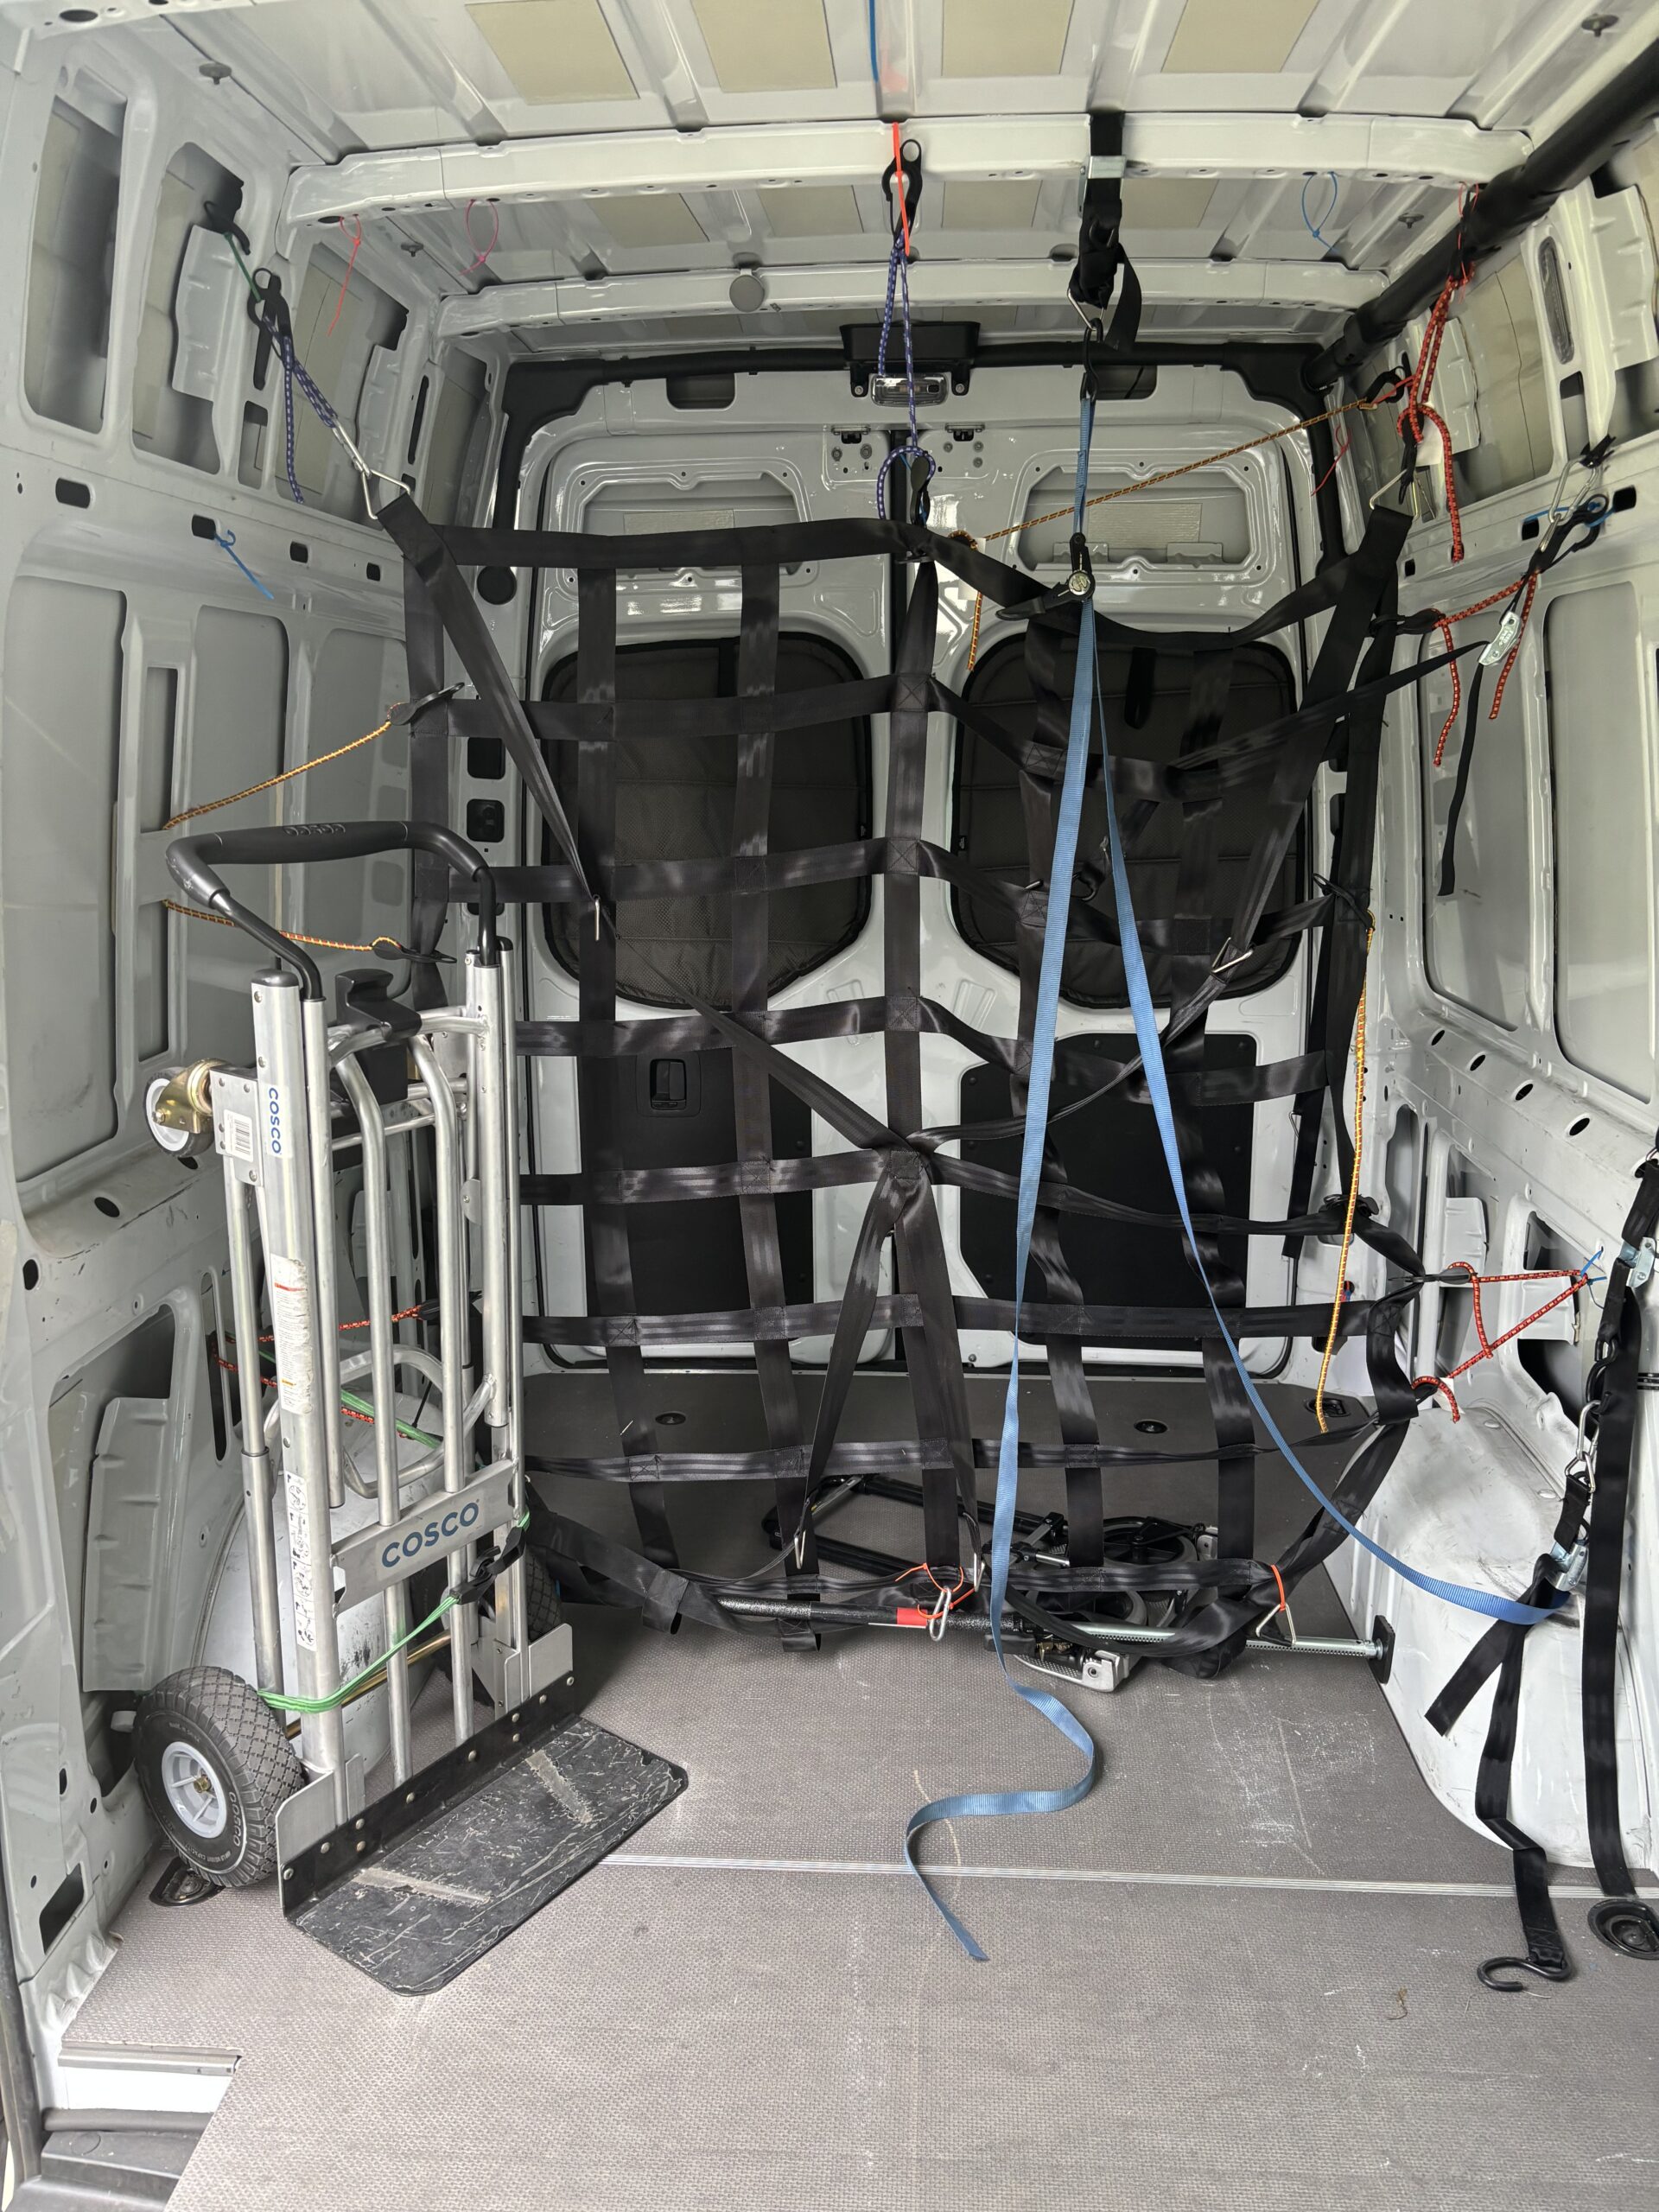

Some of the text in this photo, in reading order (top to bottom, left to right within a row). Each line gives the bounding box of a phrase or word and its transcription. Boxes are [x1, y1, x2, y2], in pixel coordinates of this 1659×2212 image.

[269, 1087, 282, 1154] COSCO
[381, 1502, 480, 1568] COSCO
[228, 1791, 242, 1847] COSCO
